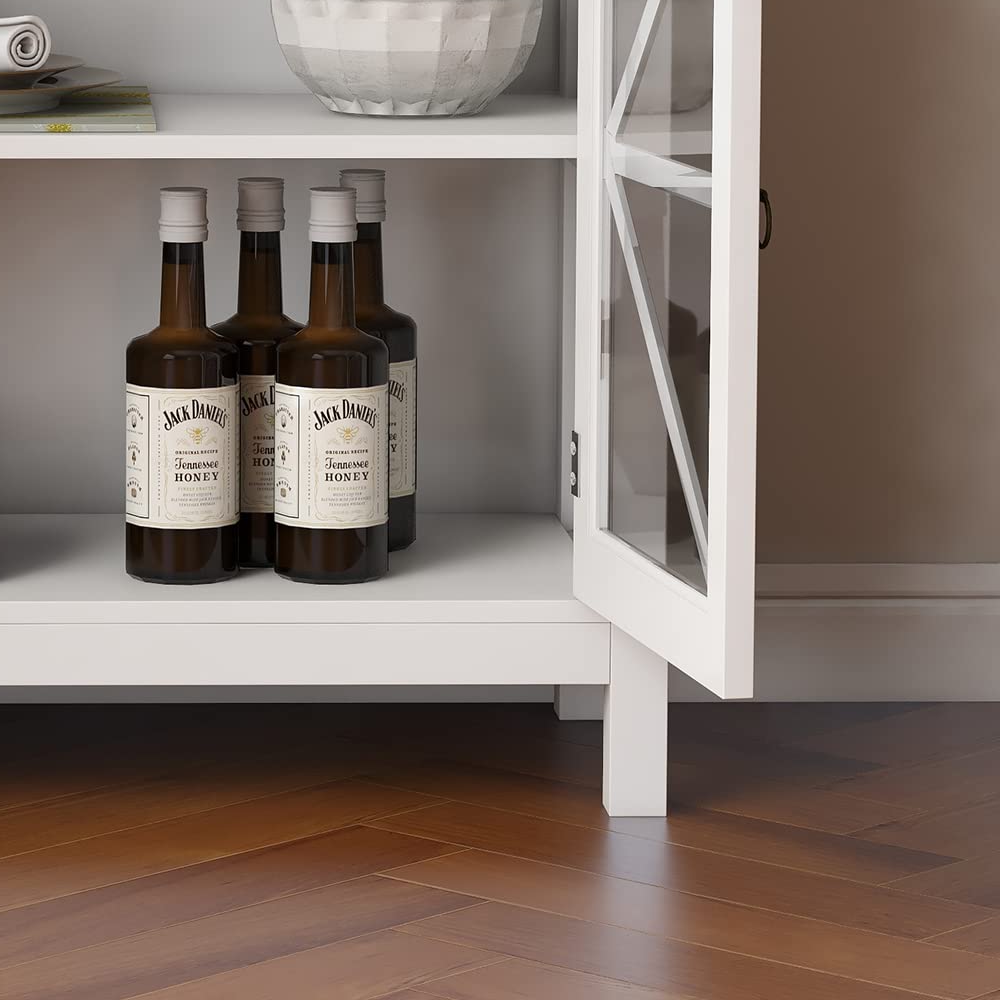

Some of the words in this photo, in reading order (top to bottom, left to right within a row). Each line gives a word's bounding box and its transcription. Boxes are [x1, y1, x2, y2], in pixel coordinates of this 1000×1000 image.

[241, 390, 269, 417] JACK
[163, 404, 191, 431] JACK
[191, 399, 228, 429] DANIEL'S
[313, 404, 342, 431] JACK
[342, 398, 378, 429] DANIEL'S
[174, 457, 219, 470] Tennessee
[324, 457, 369, 470] Tennessee
[174, 471, 219, 482] HONEY
[324, 471, 369, 482] HONEY
